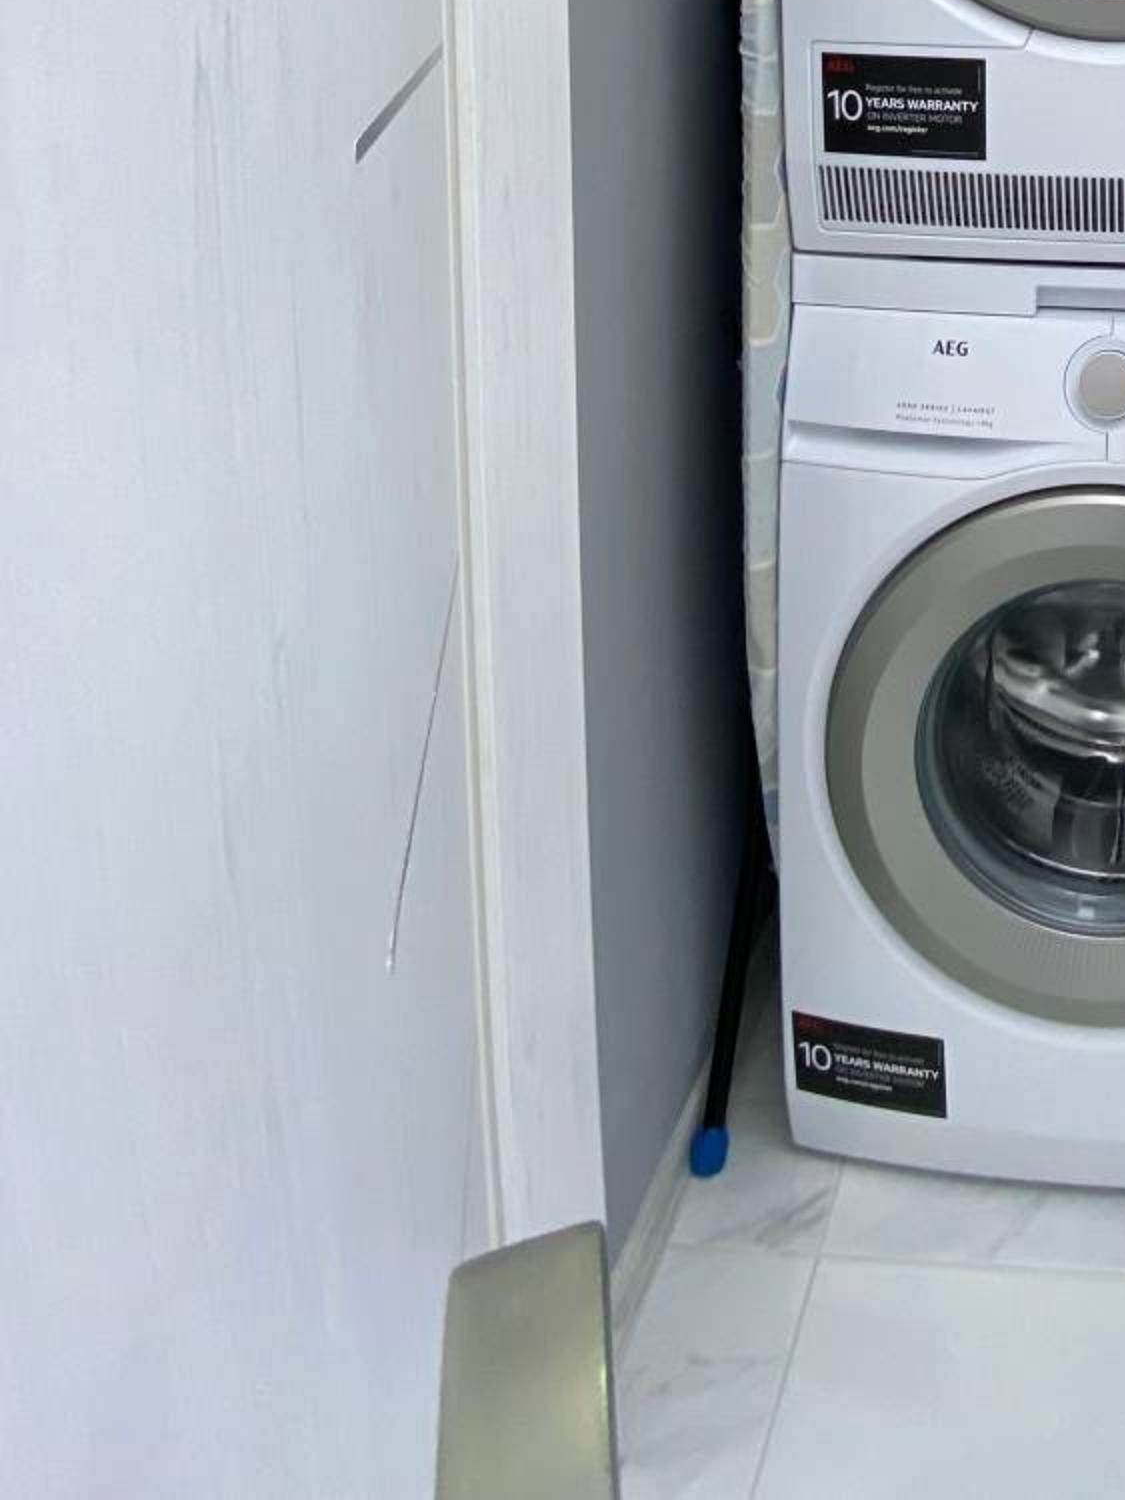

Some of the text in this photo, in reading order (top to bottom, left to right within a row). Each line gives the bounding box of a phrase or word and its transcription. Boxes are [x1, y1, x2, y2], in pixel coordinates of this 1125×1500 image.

[827, 88, 863, 122] 10
[865, 96, 979, 113] YEARS WARRANTY
[867, 112, 963, 125] ON INVERTER MOTOR
[932, 339, 970, 358] AEG
[799, 1042, 832, 1071] 10
[834, 1053, 871, 1070] YEARS
[873, 1060, 940, 1081] WARRANTY
